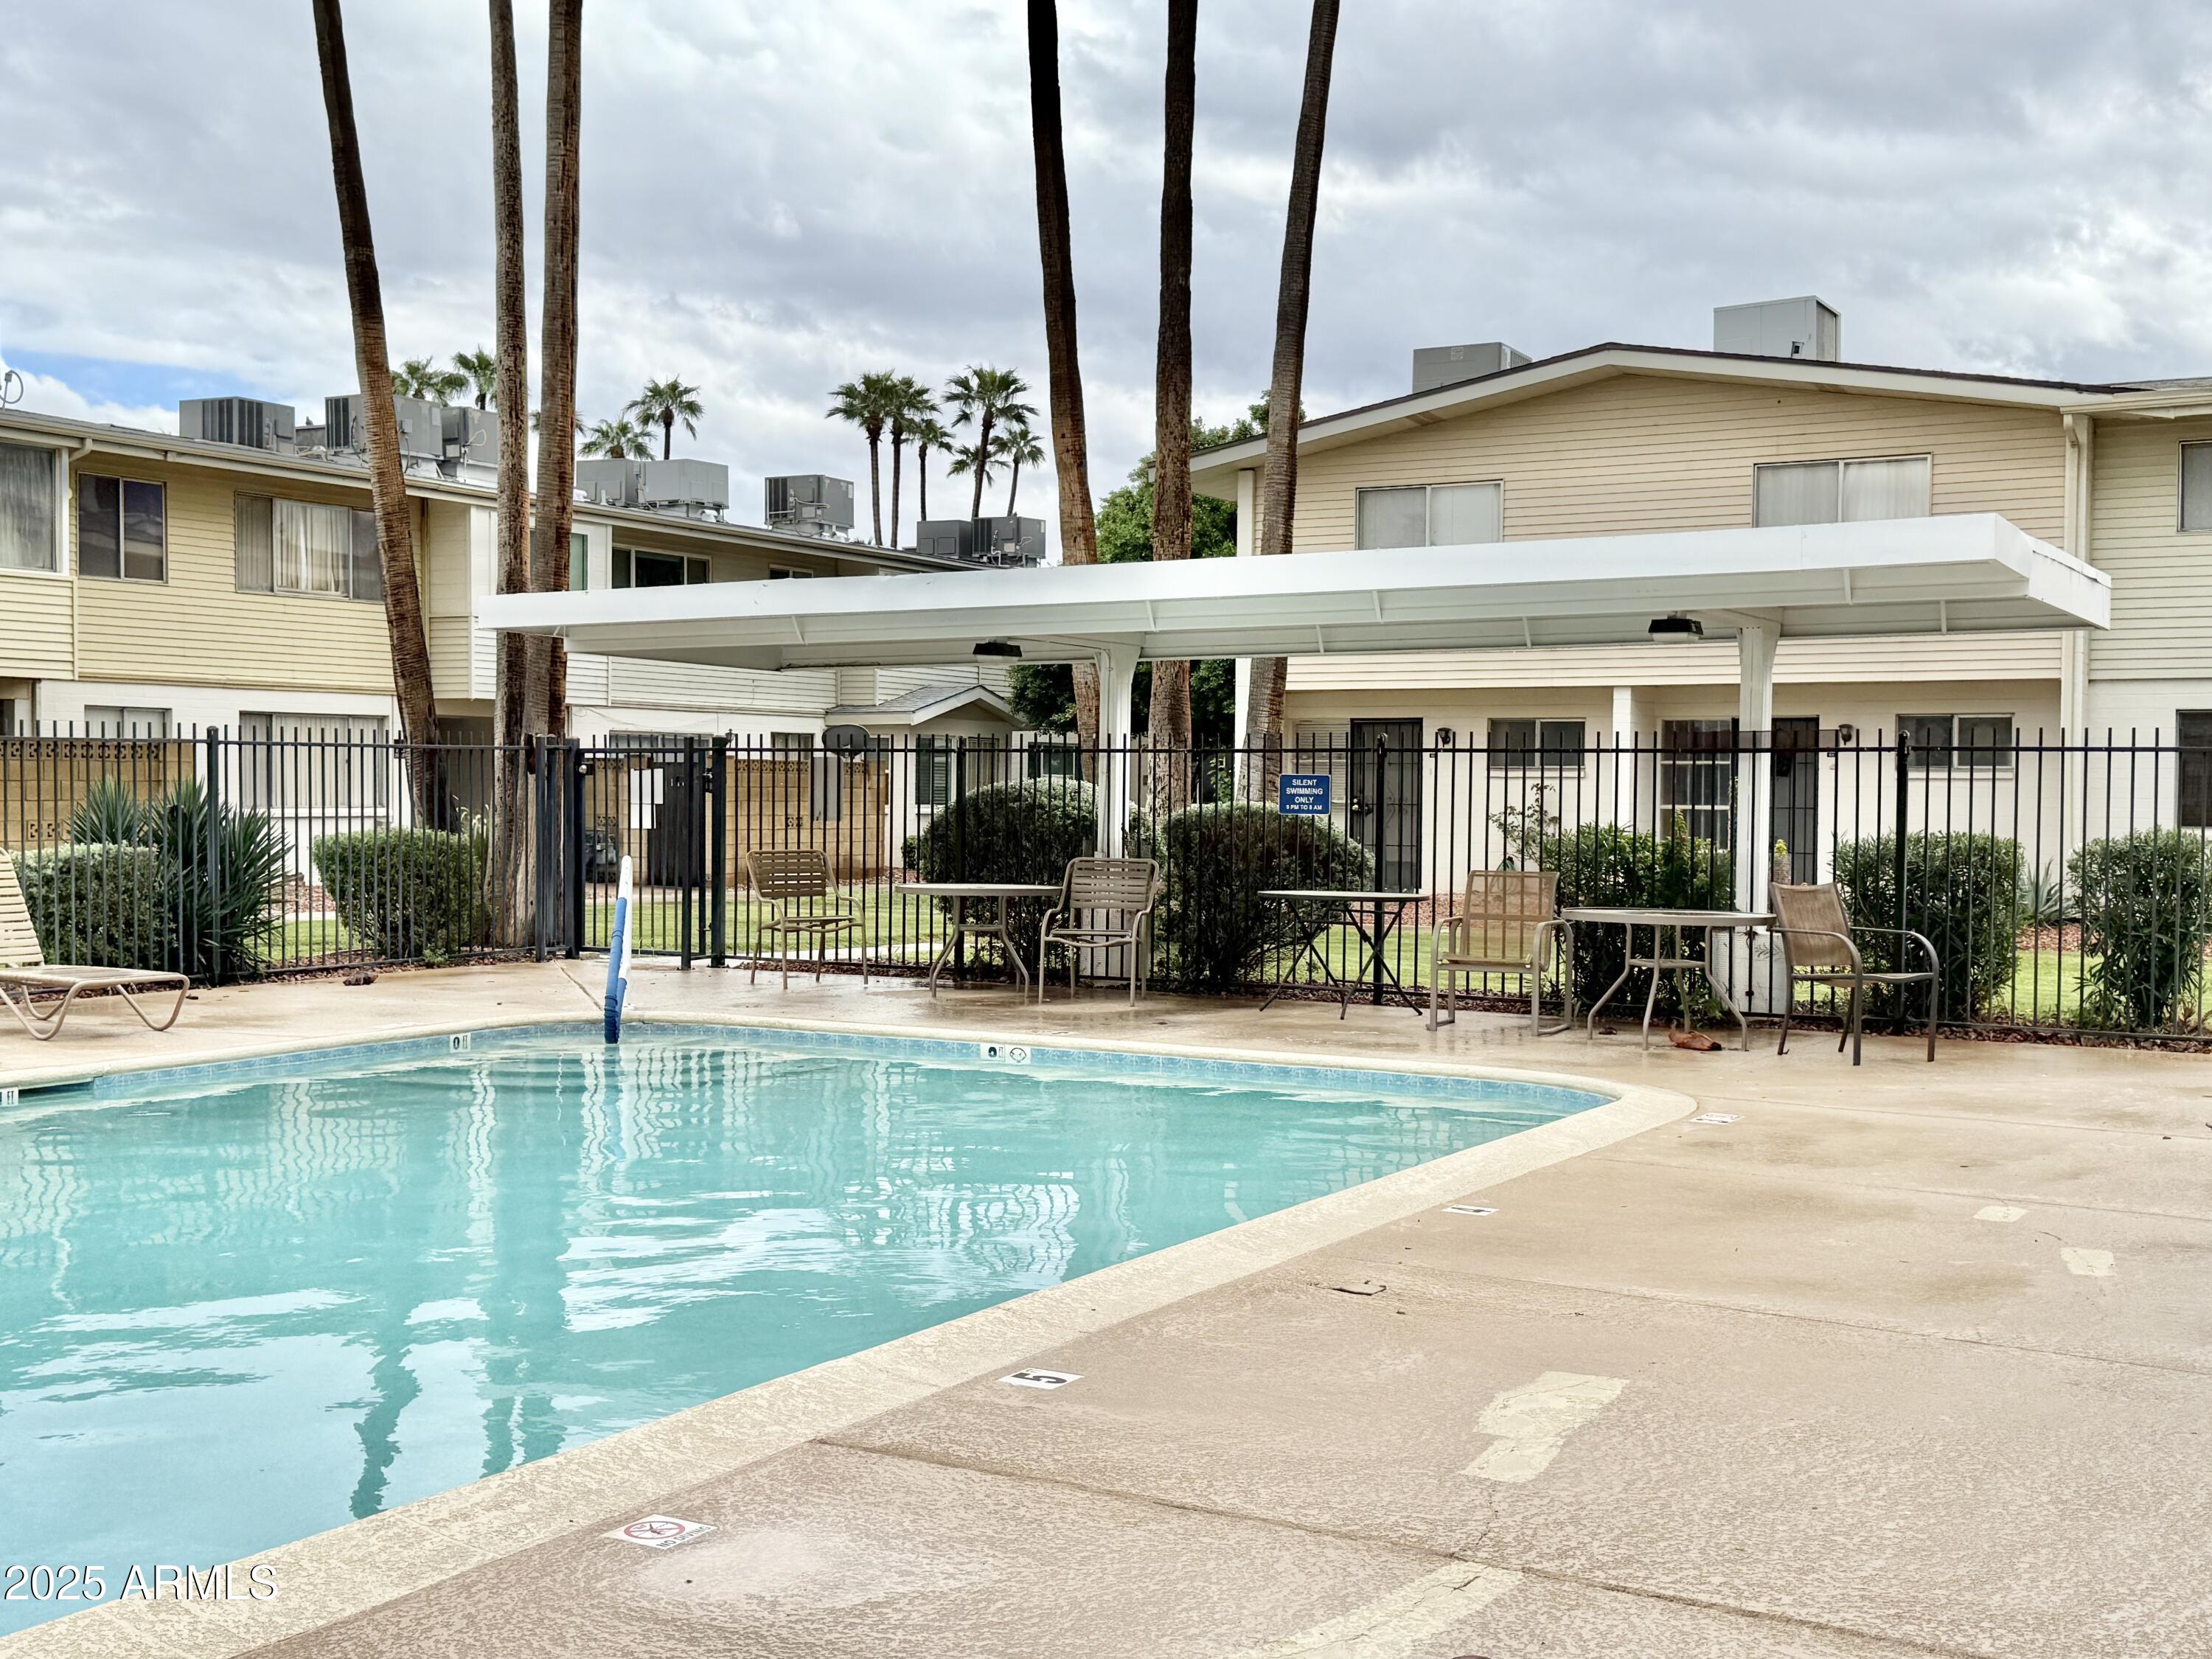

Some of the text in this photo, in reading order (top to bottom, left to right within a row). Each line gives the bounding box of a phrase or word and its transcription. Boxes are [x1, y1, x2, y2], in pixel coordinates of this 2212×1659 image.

[1011, 1372, 1068, 1384] 5
[655, 1526, 712, 1548] NO DIVING
